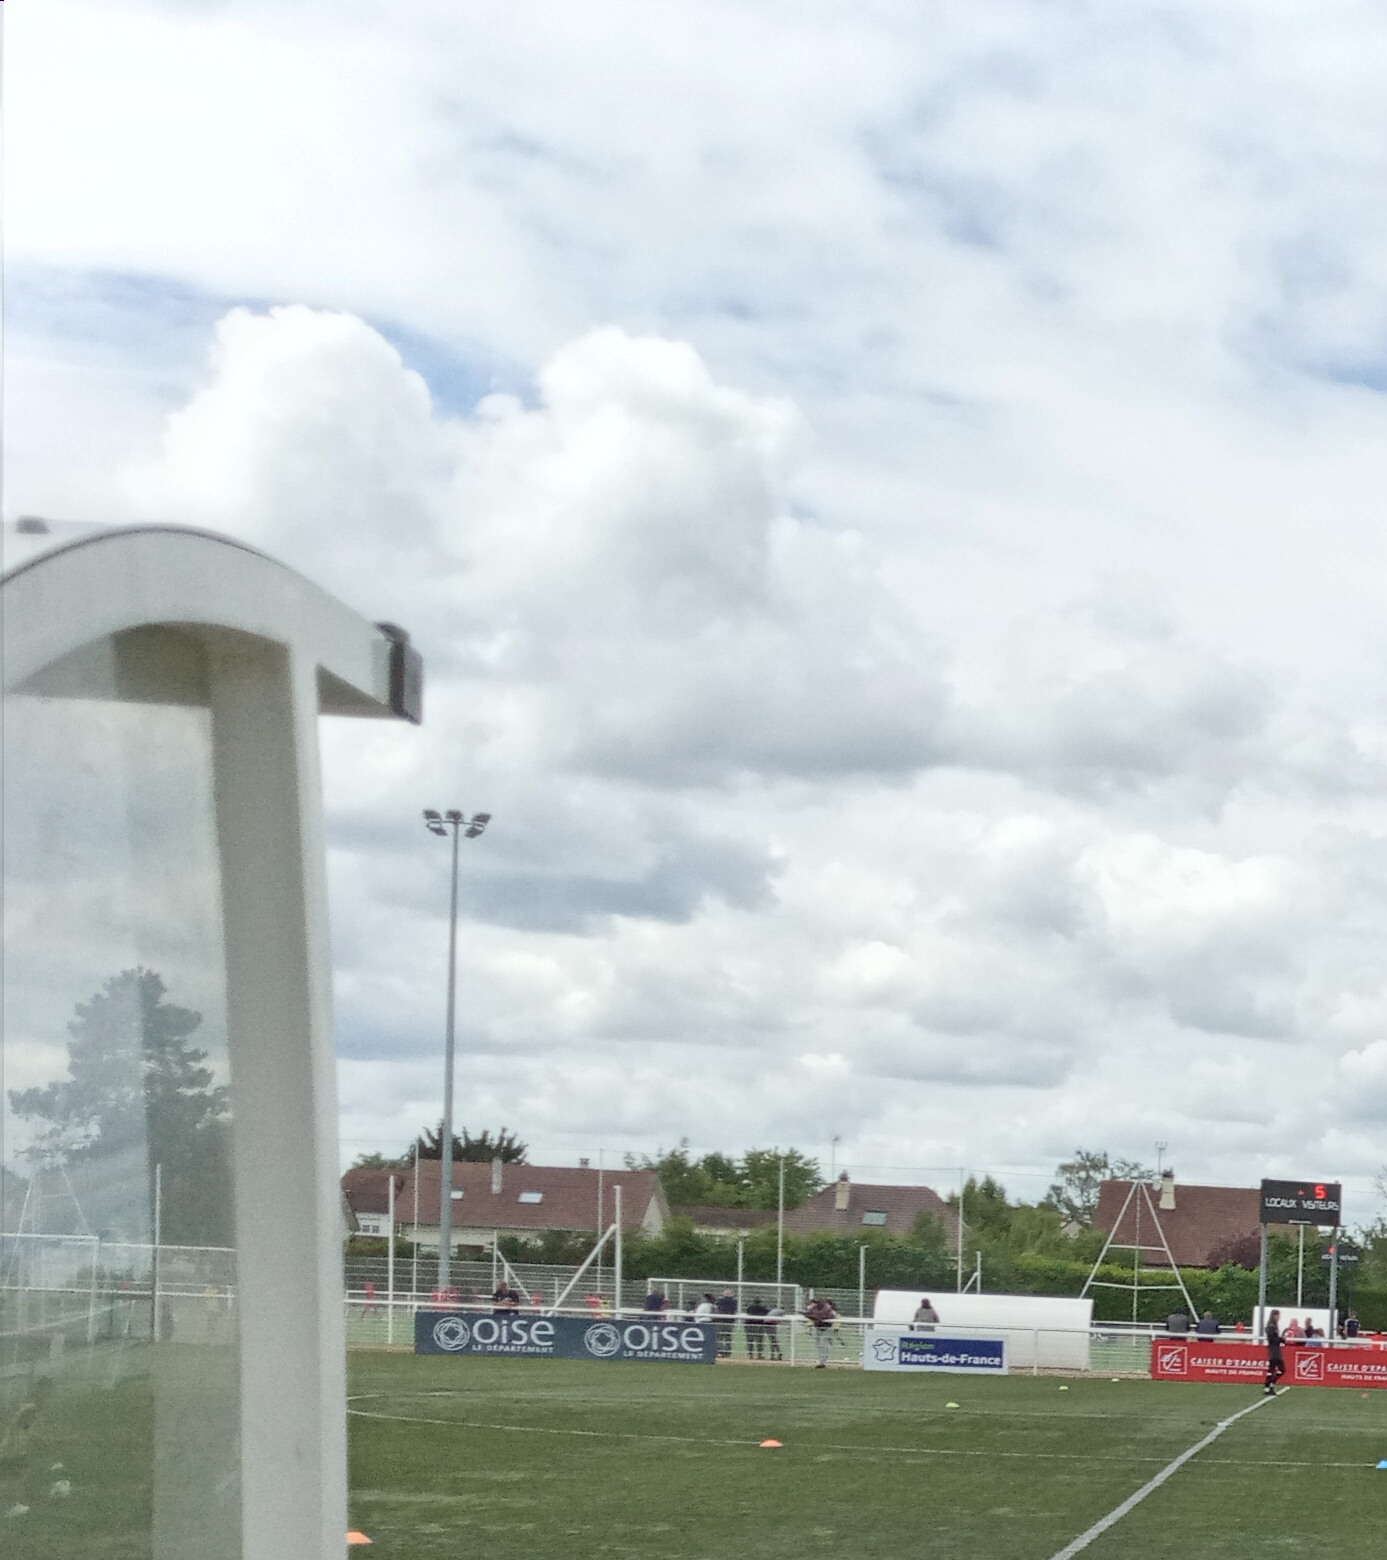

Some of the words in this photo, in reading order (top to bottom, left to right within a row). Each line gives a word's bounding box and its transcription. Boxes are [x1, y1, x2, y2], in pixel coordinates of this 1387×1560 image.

[1265, 1197, 1297, 1208] LOCAUX
[1301, 1200, 1339, 1211] VISITEURS
[901, 1351, 1001, 1366] Hauts-de-France
[1190, 1357, 1223, 1366] CAISSE
[1327, 1363, 1359, 1371] CAISSE
